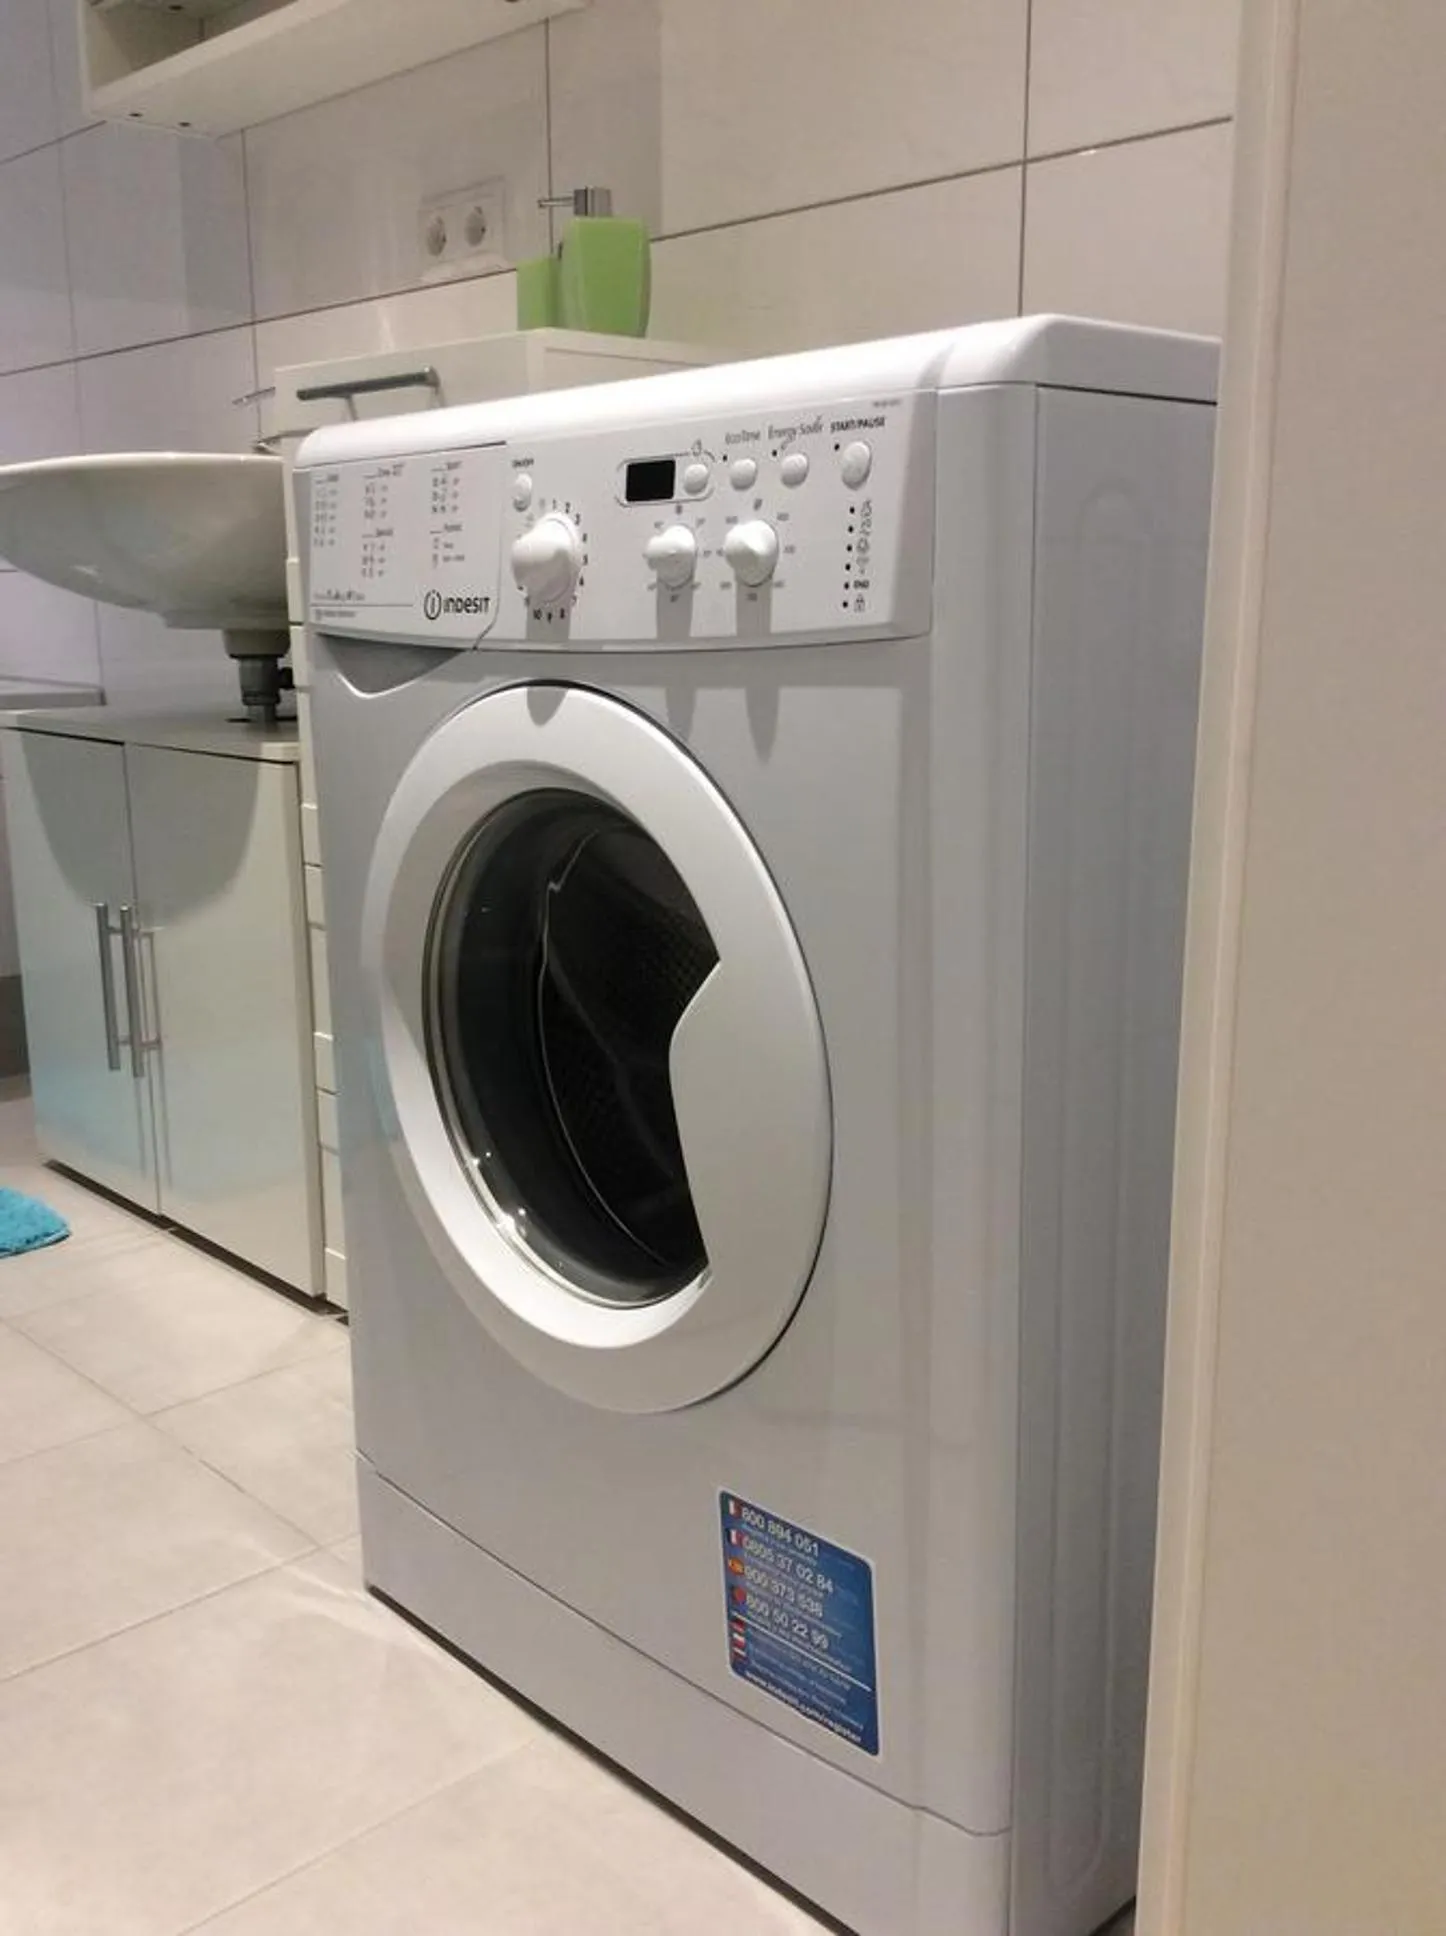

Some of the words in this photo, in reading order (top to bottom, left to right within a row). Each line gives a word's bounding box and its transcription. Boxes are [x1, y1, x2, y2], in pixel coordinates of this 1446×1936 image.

[742, 1507, 765, 1529] 800
[796, 1565, 814, 1584] 02
[817, 1574, 833, 1593] 84
[791, 1620, 808, 1637] 22
